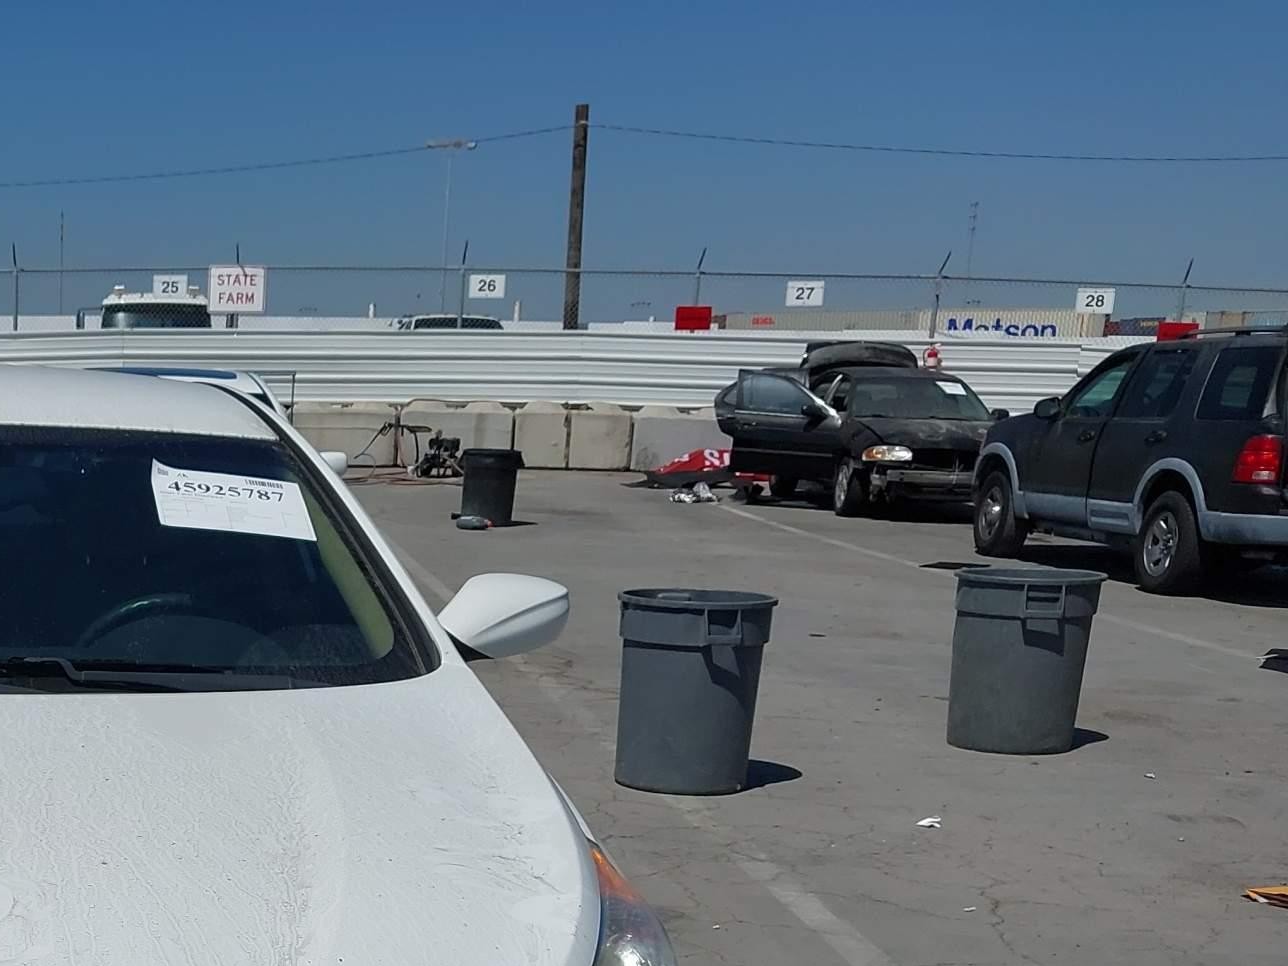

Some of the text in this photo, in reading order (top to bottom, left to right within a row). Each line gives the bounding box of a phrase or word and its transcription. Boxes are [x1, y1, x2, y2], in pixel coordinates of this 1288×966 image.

[161, 280, 179, 294] 25
[217, 274, 257, 287] STATE
[477, 279, 497, 293] 26
[218, 291, 255, 305] FARM
[795, 286, 815, 300] 27
[1084, 294, 1105, 308] 28
[168, 481, 283, 502] 45925787
